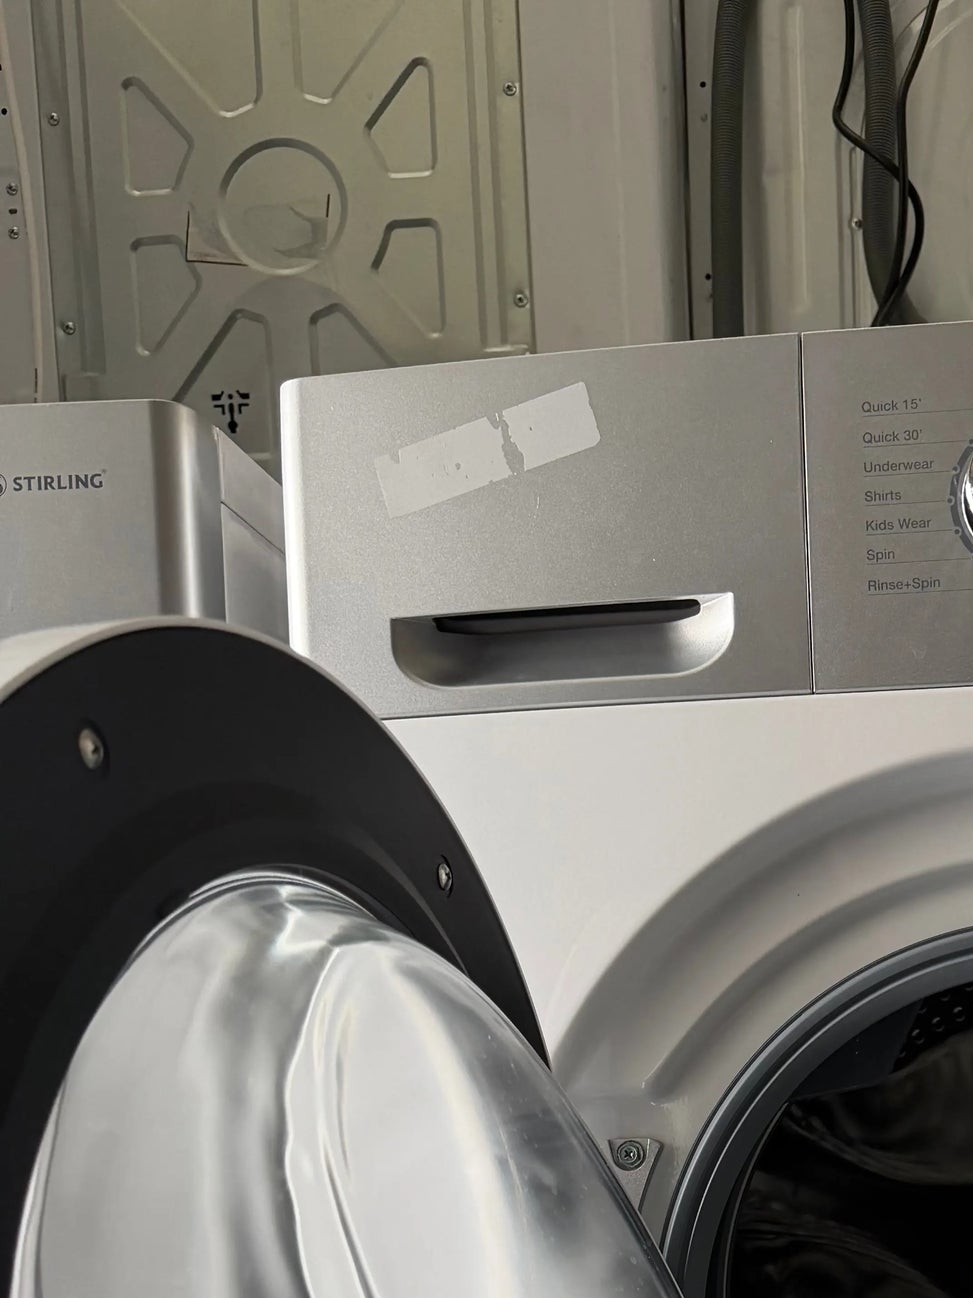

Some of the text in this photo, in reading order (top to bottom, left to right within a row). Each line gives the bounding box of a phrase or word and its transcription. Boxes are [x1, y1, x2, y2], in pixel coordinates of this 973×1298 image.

[861, 399, 899, 413] Quick
[862, 430, 900, 444] Quick
[863, 459, 934, 473] Underwear
[13, 473, 103, 492] STIRLING
[864, 490, 902, 502] Shirts
[865, 518, 932, 532] Kids Wear
[866, 549, 895, 563] Spin
[868, 577, 941, 592] Rinse+Spin
